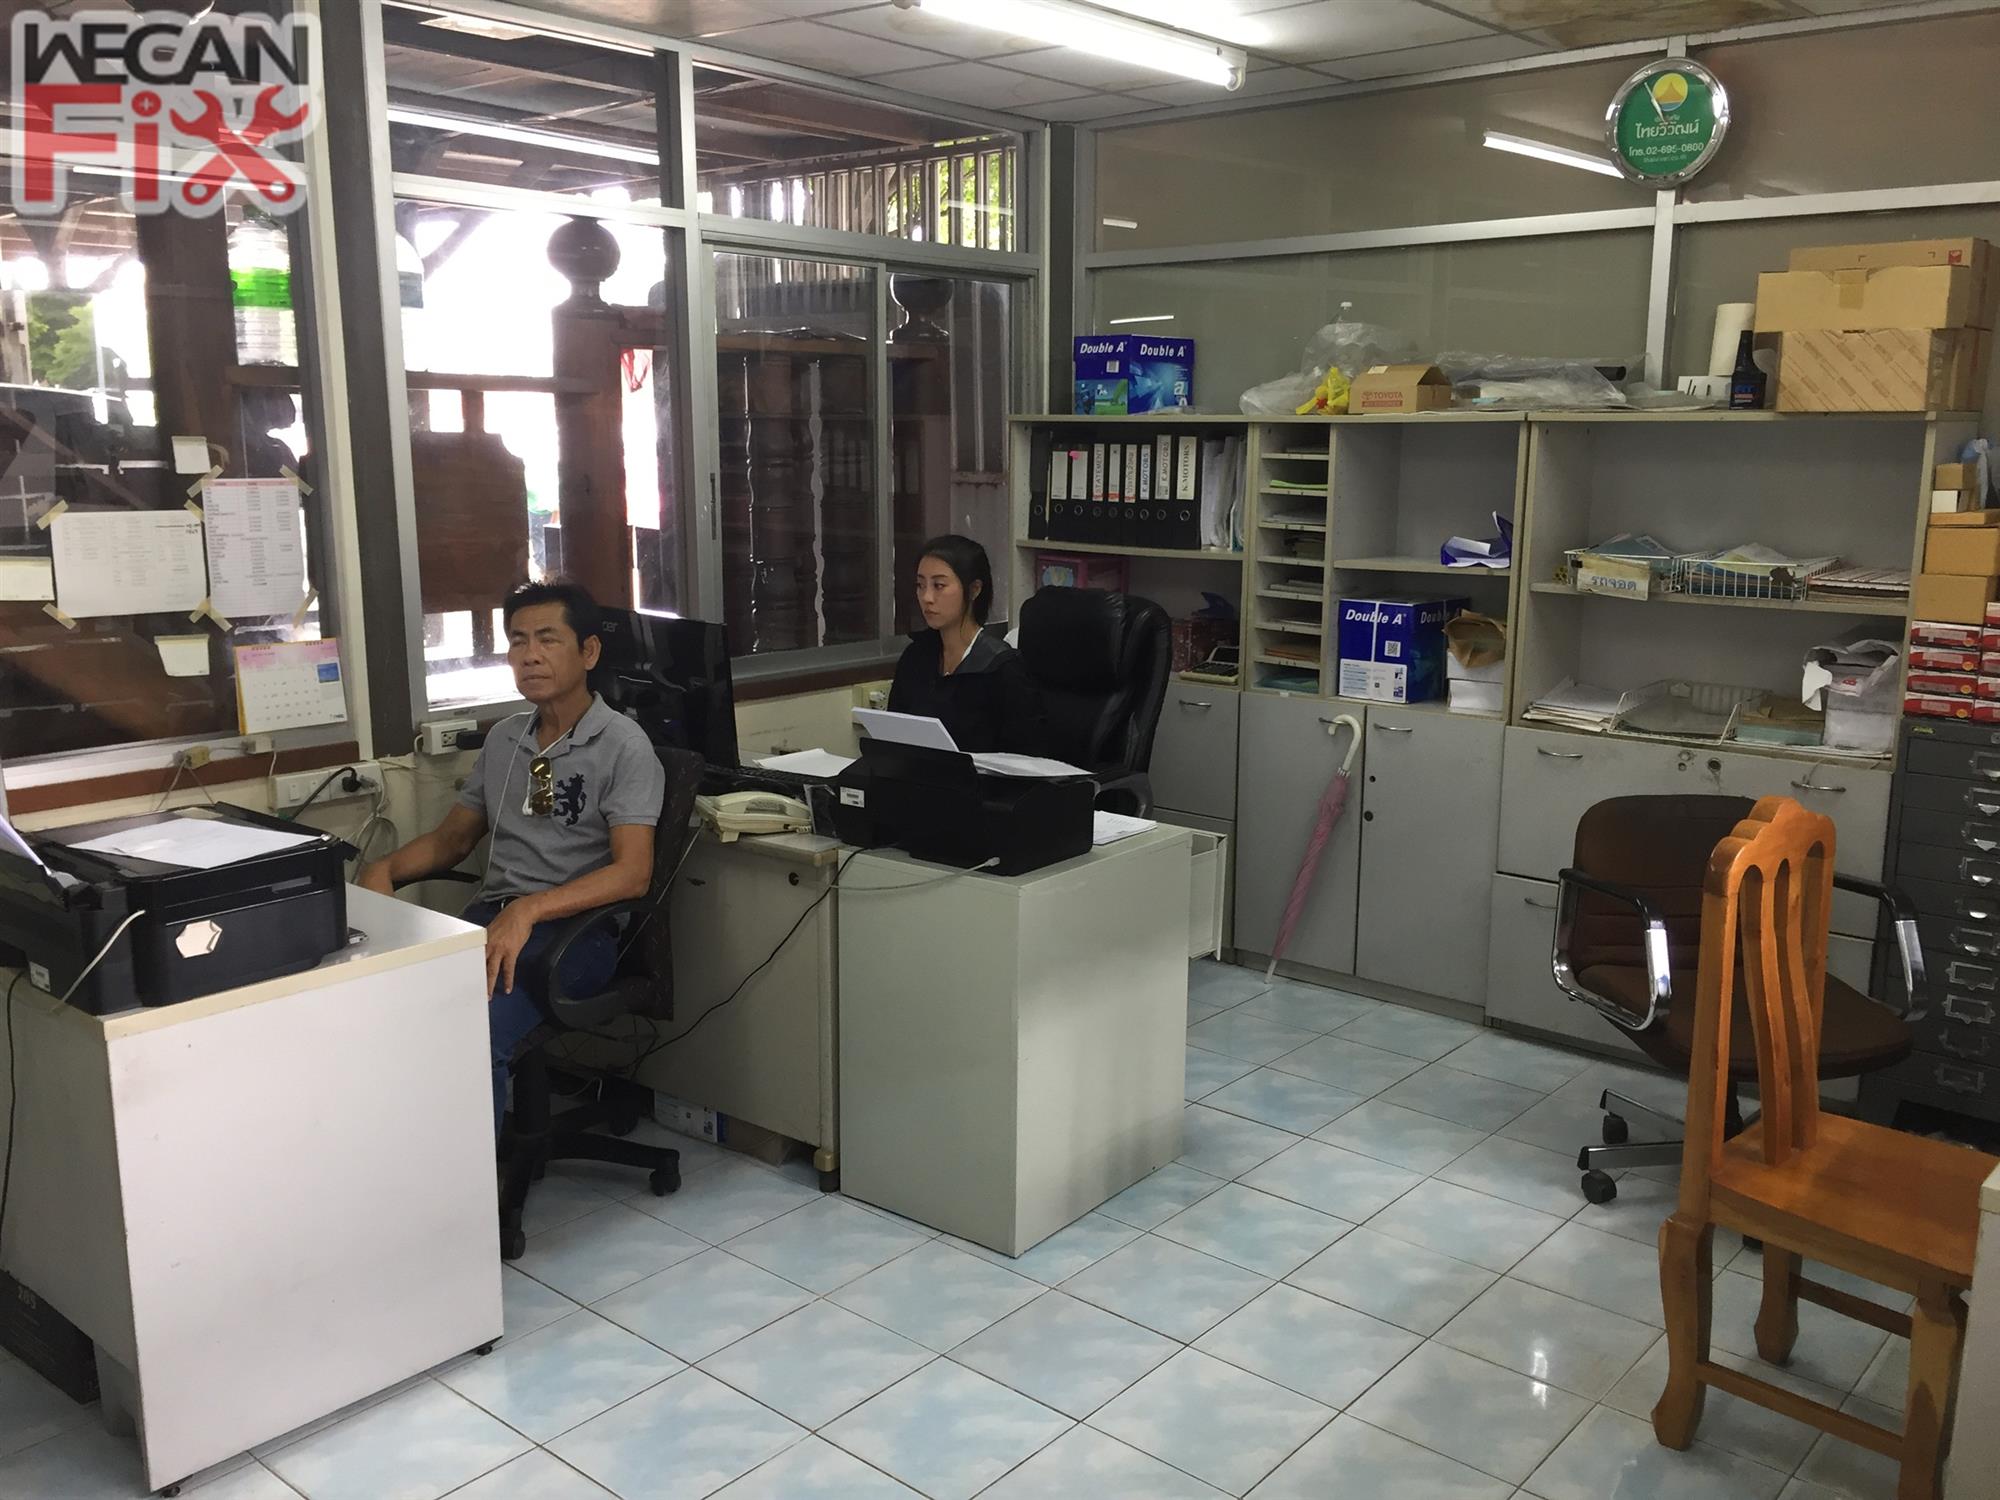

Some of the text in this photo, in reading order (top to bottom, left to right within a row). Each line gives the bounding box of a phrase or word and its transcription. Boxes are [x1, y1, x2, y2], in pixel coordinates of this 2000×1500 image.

[1080, 343, 1114, 354] Double
[1140, 344, 1175, 357] Double
[1373, 391, 1403, 399] TOYOTA
[1345, 609, 1389, 624] Double
